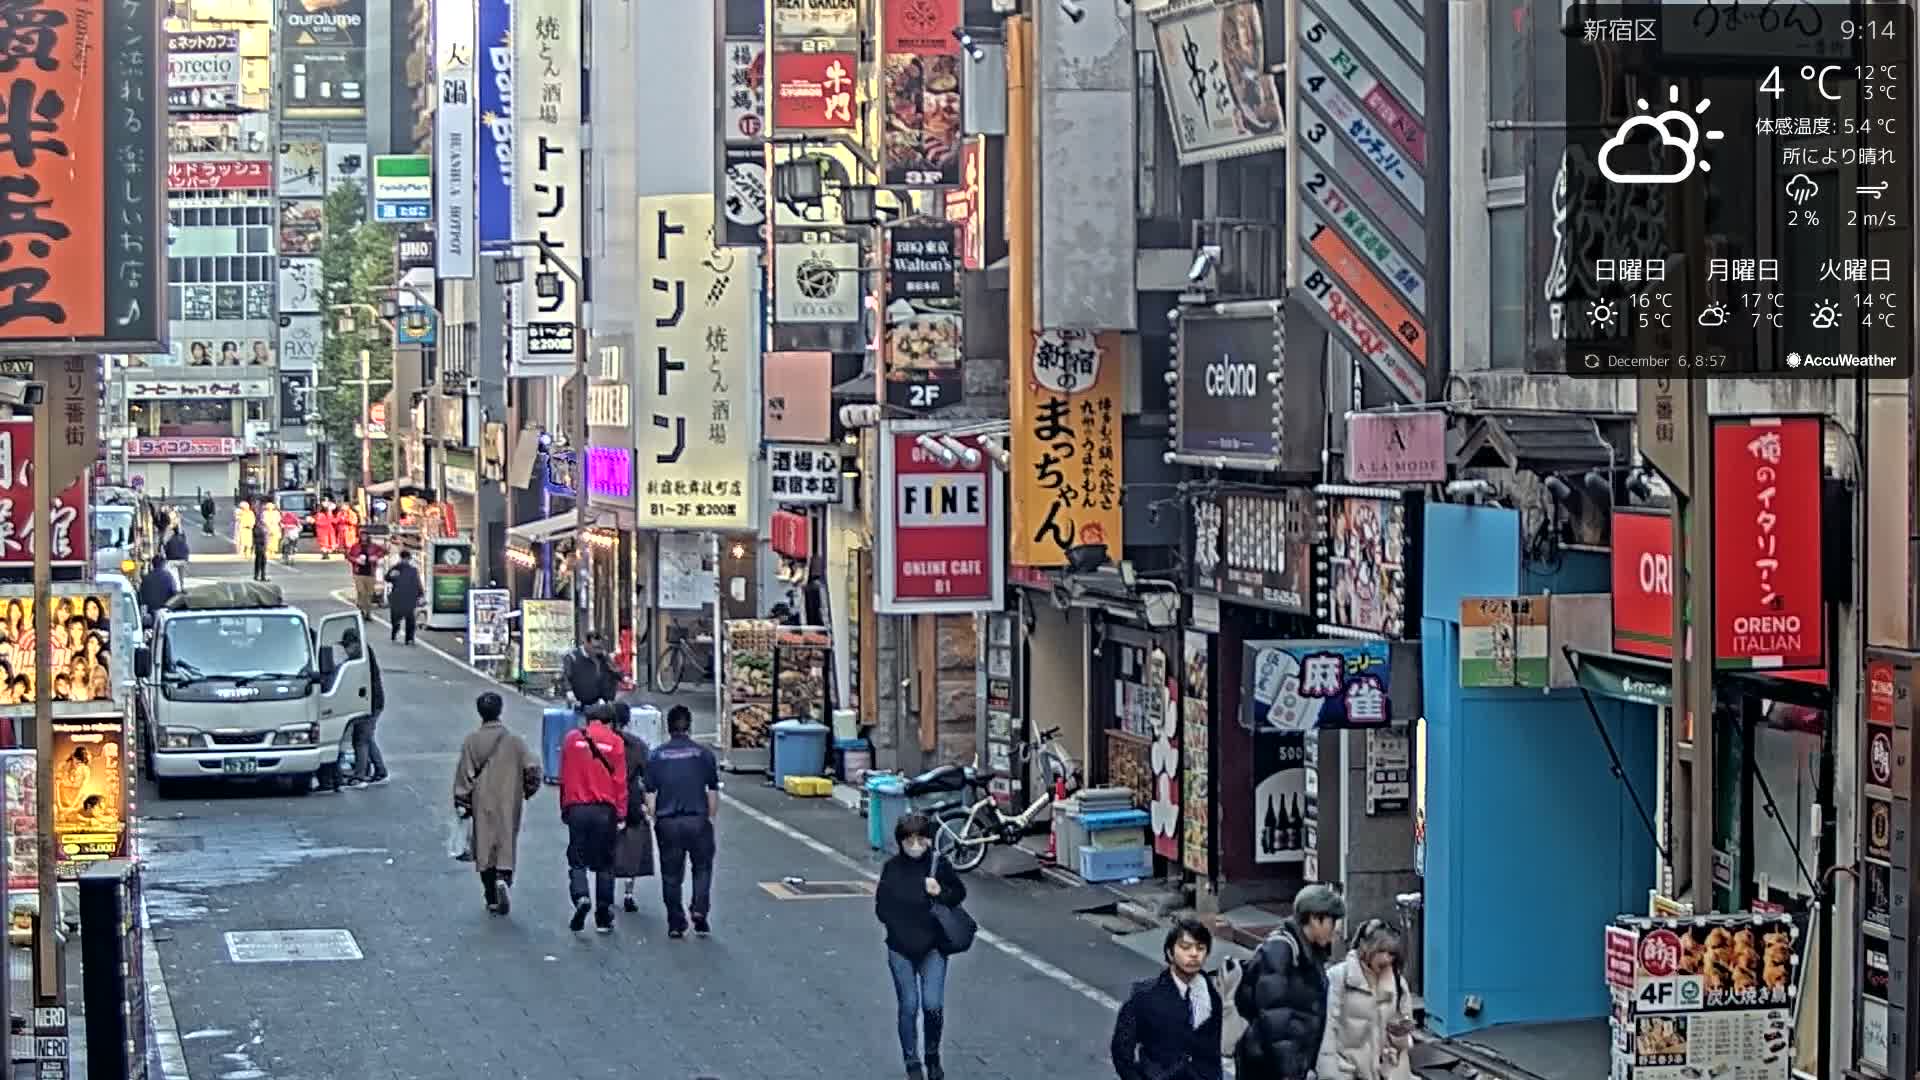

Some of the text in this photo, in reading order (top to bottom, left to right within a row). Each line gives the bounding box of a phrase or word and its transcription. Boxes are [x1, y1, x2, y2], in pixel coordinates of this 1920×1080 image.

[1307, 23, 1327, 44] 5
[824, 59, 852, 122] 牛門
[1306, 75, 1327, 93] 4
[1350, 118, 1405, 182] センチュリー
[1307, 123, 1327, 144] 3
[1306, 172, 1327, 194] 2
[535, 136, 564, 312] トントン
[1304, 270, 1333, 299] B1
[652, 209, 686, 464] トントン
[705, 326, 730, 445] 焼とん酒場
[1205, 353, 1256, 397] celona
[909, 385, 940, 407] 2F
[772, 451, 836, 473] 酒場心
[1034, 396, 1079, 550] まっちゃん
[772, 475, 837, 495] 新宿本店
[904, 485, 980, 515] FINE
[1747, 431, 1783, 607] 俺のイタリアン
[902, 560, 982, 576] ONLINE CAFE
[934, 579, 951, 594] B1
[1733, 616, 1801, 635] ORENO
[1733, 635, 1802, 652] ITALIAN
[1640, 983, 1673, 1004] 4F
